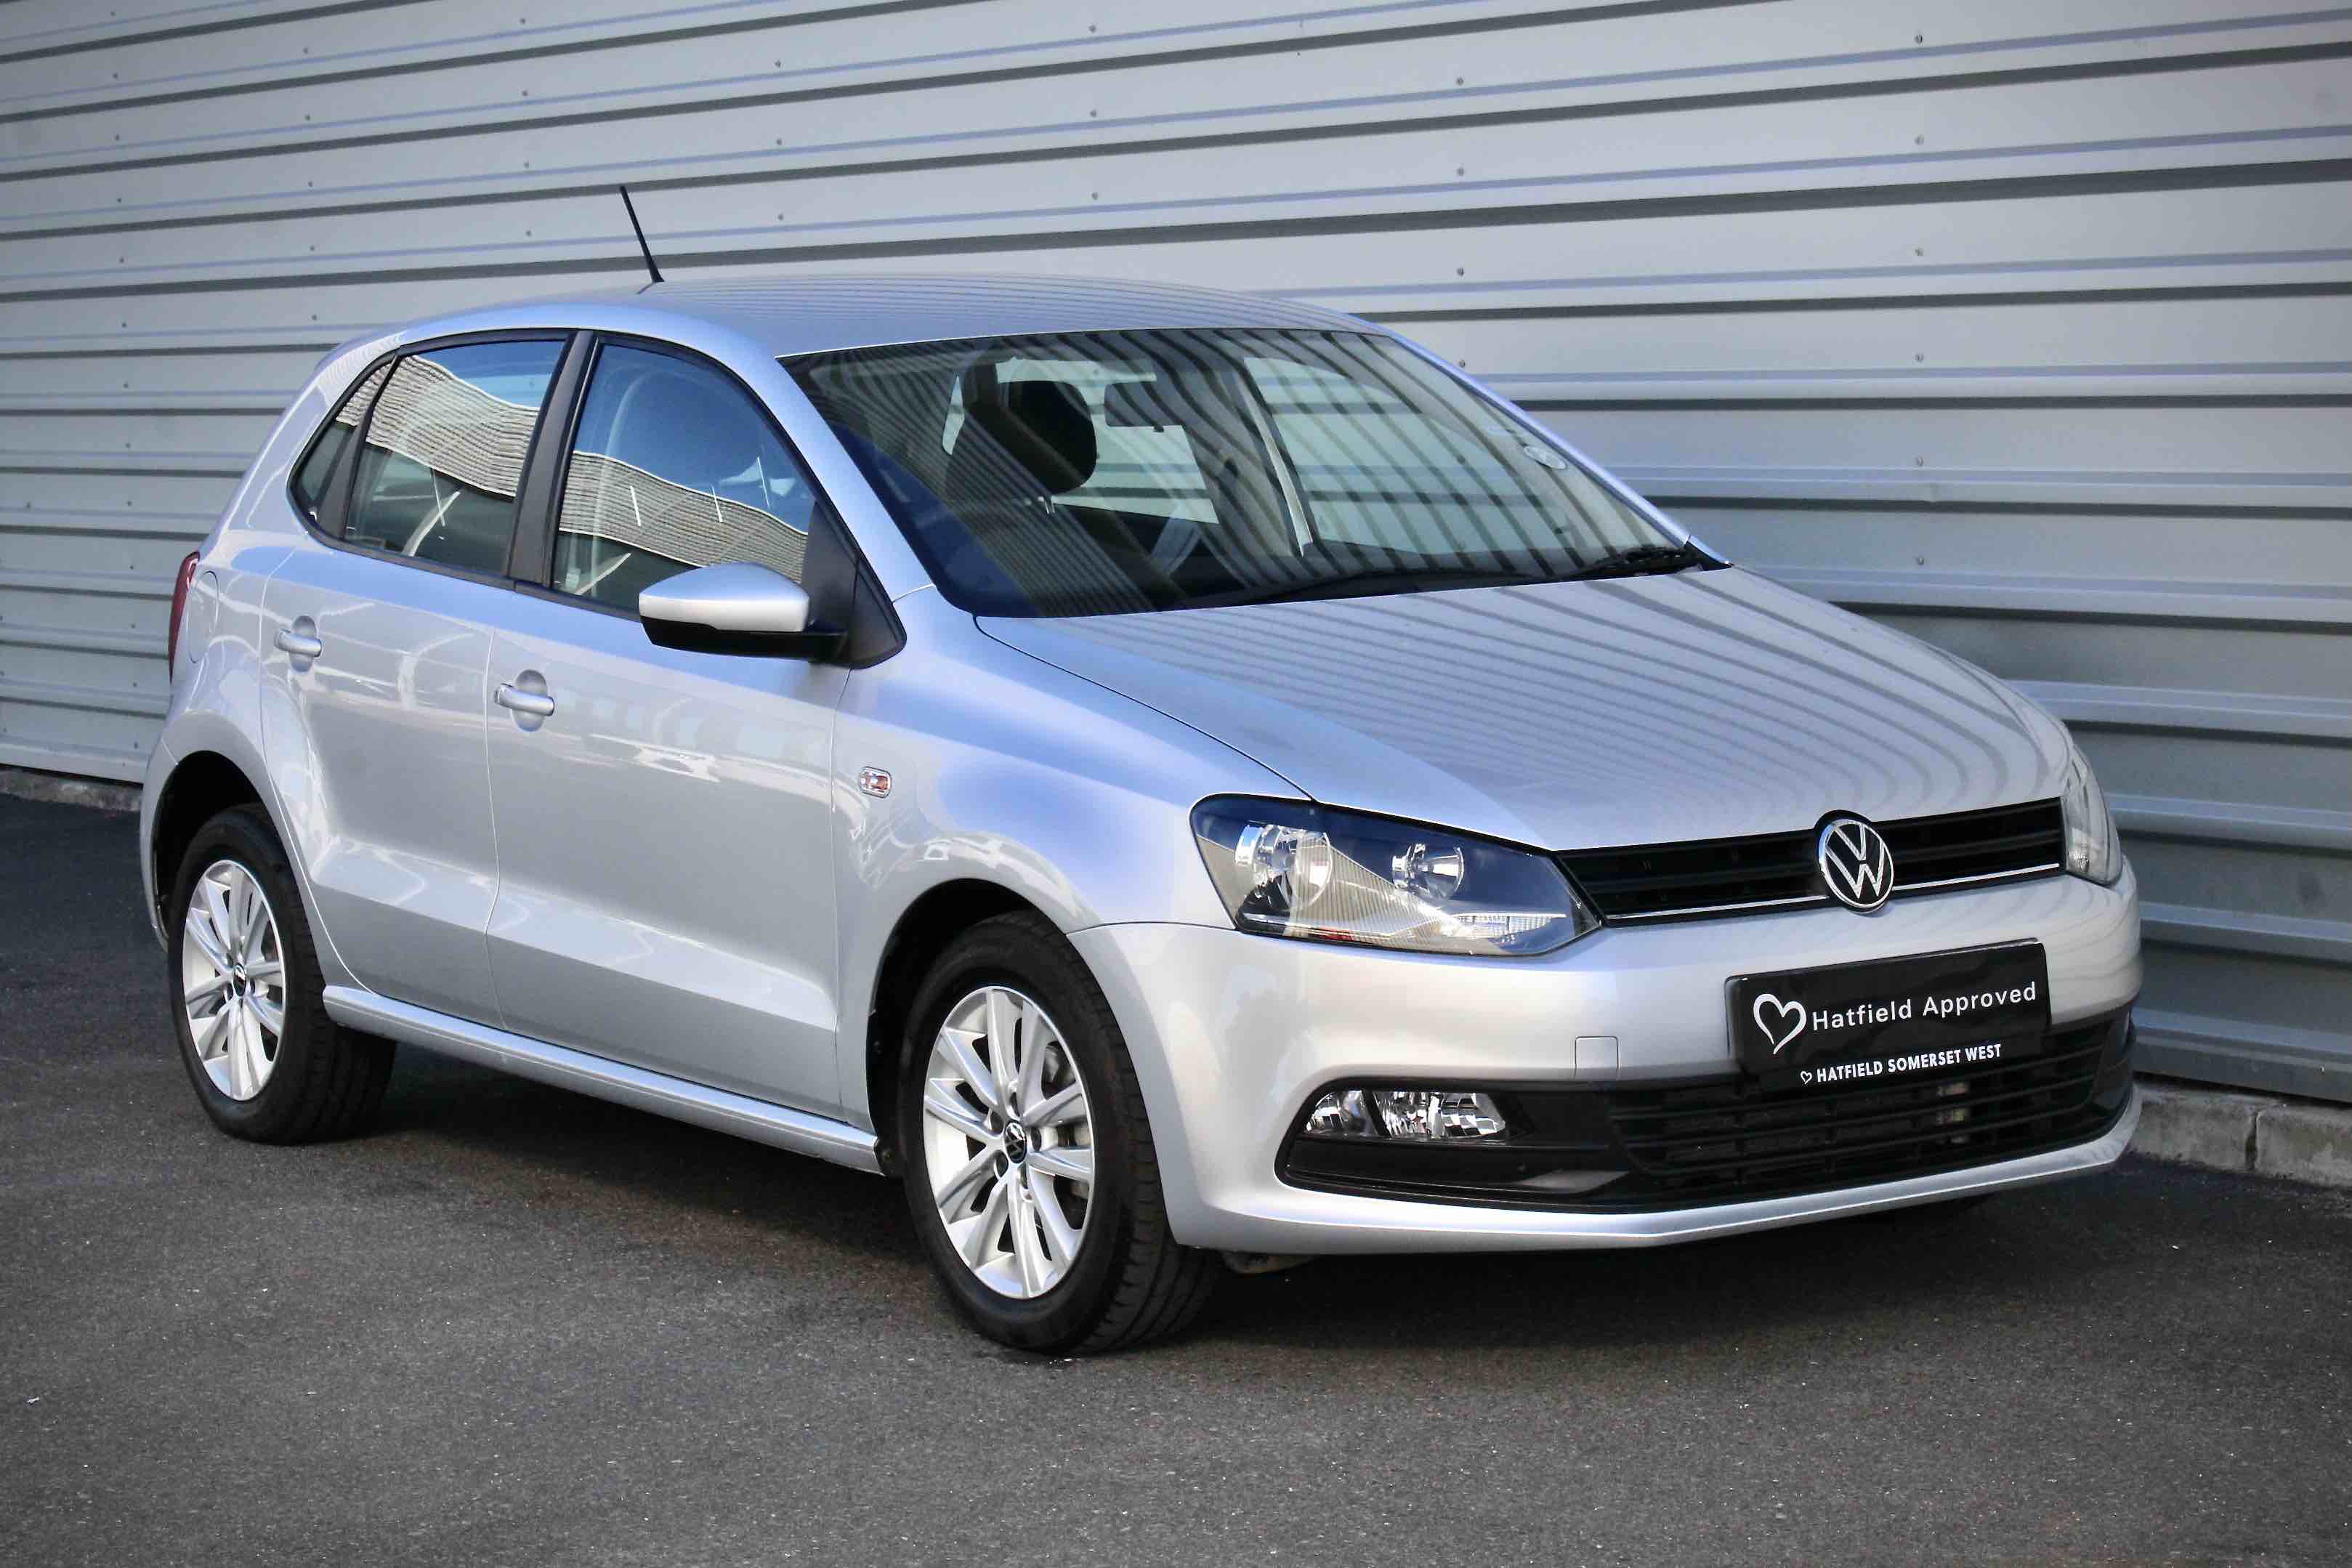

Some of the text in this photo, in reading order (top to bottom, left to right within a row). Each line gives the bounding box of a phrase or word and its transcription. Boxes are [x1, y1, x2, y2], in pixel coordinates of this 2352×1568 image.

[1821, 820, 1891, 903] VW
[1812, 981, 2036, 1031] Hatfield Approved
[1816, 1043, 2001, 1083] HATFIELD SOMERSET WEST
